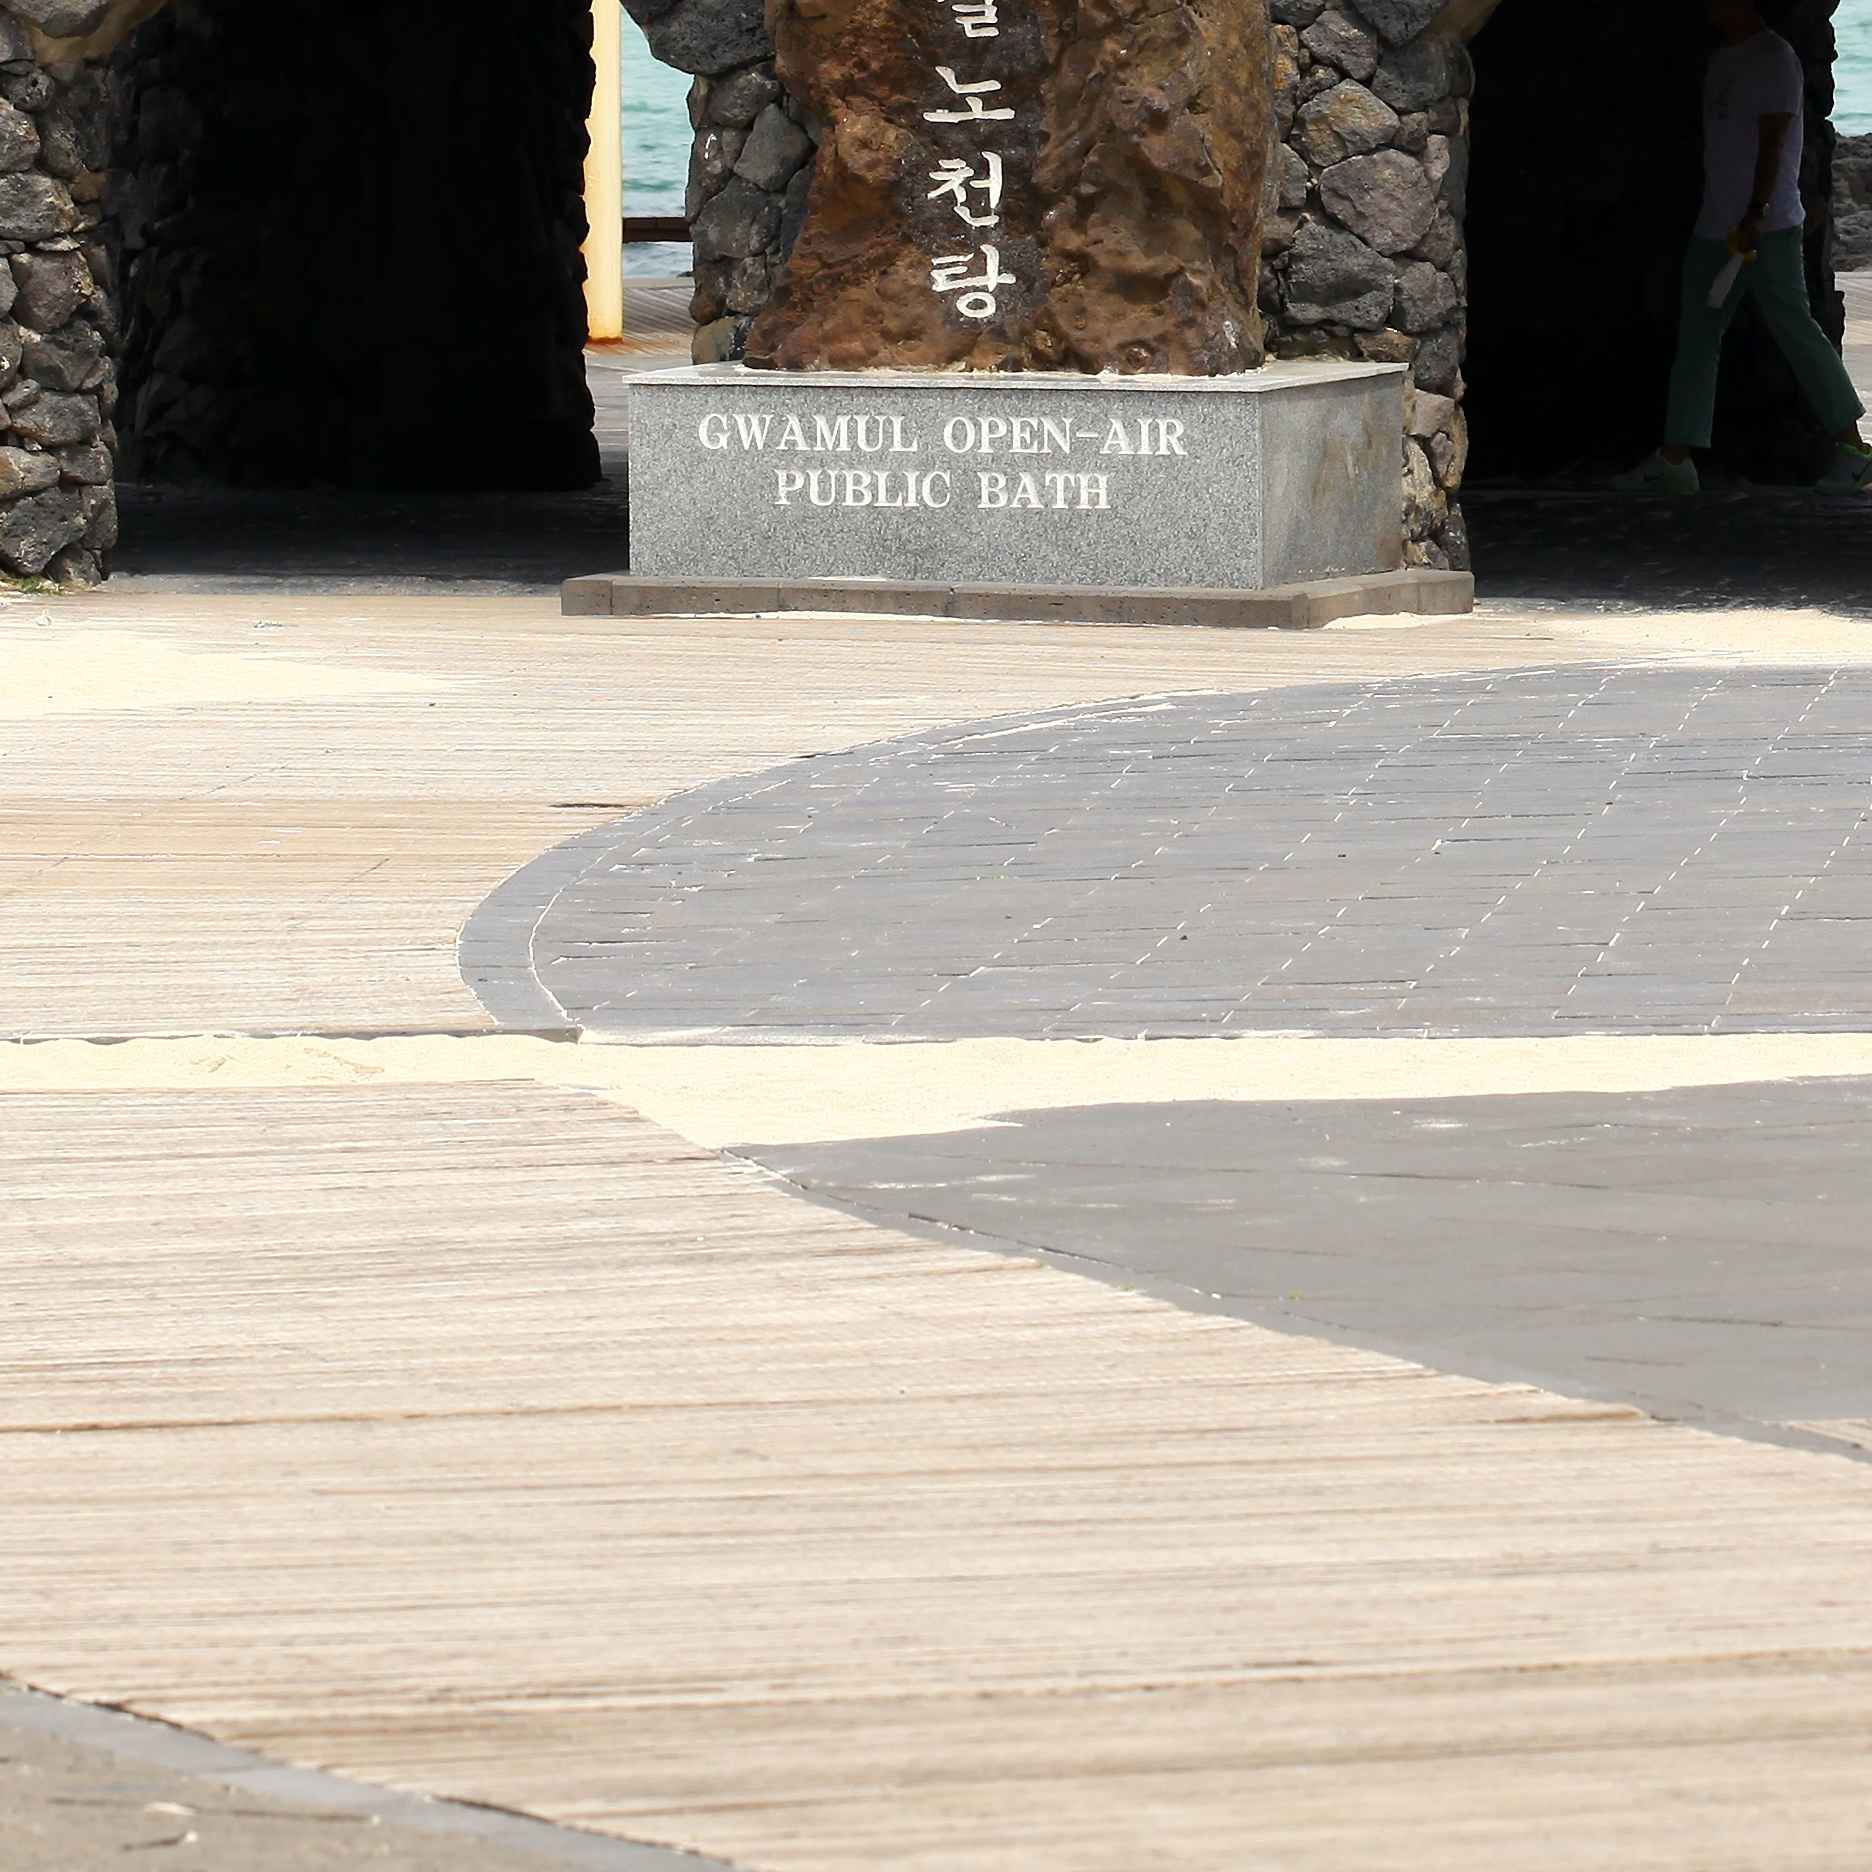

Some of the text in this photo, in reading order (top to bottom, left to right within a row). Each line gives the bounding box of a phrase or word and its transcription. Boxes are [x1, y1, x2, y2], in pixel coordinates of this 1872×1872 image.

[698, 412, 1190, 456] GWAMUL OPEN-AIR
[774, 468, 1112, 510] PUBLIC BATH
